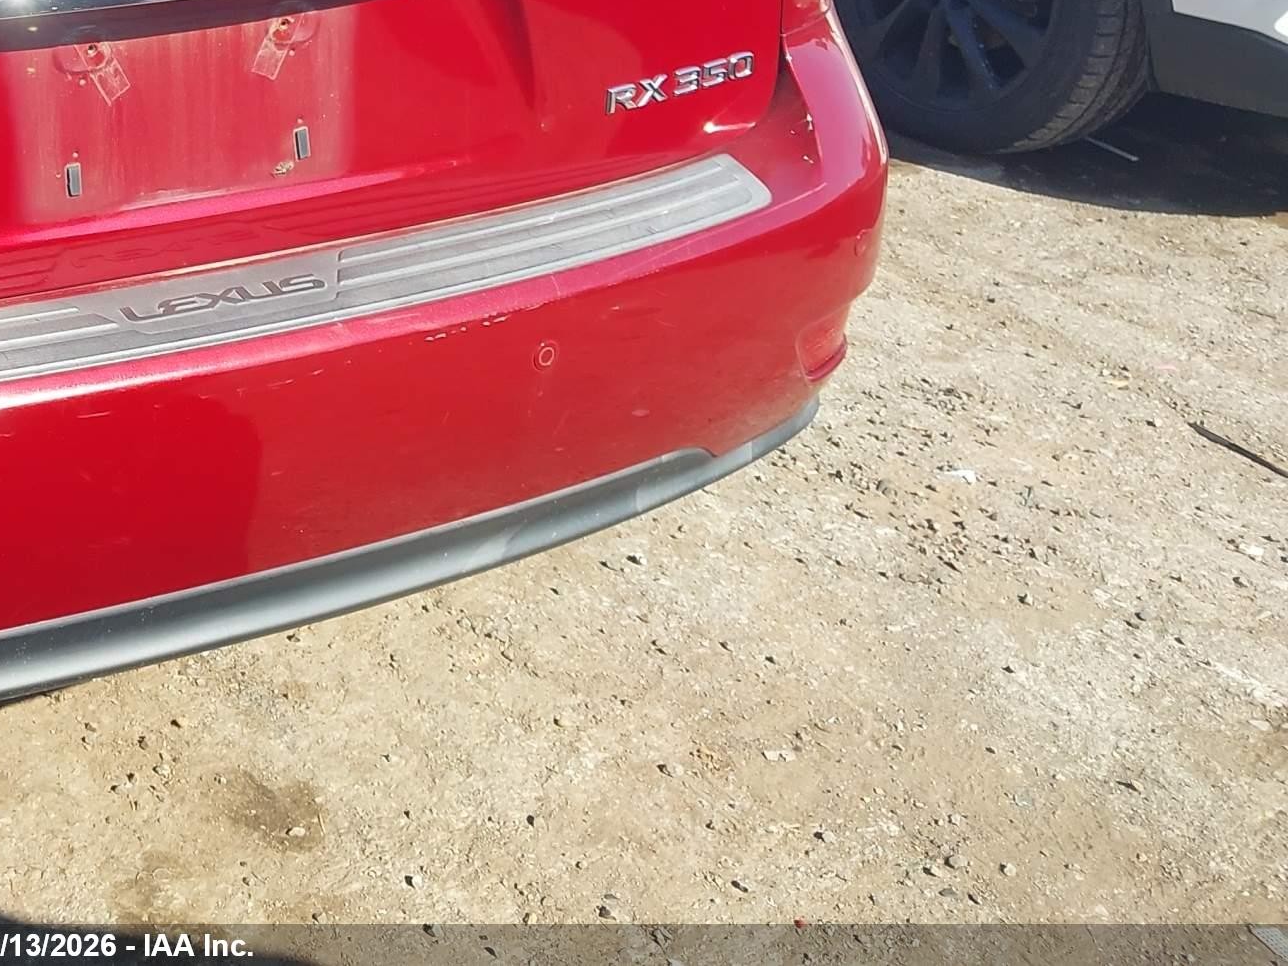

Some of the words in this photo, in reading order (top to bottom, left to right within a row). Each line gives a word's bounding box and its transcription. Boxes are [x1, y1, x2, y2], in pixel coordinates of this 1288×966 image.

[605, 73, 668, 115] RX
[673, 50, 755, 97] 350
[119, 273, 326, 322] LEXUS
